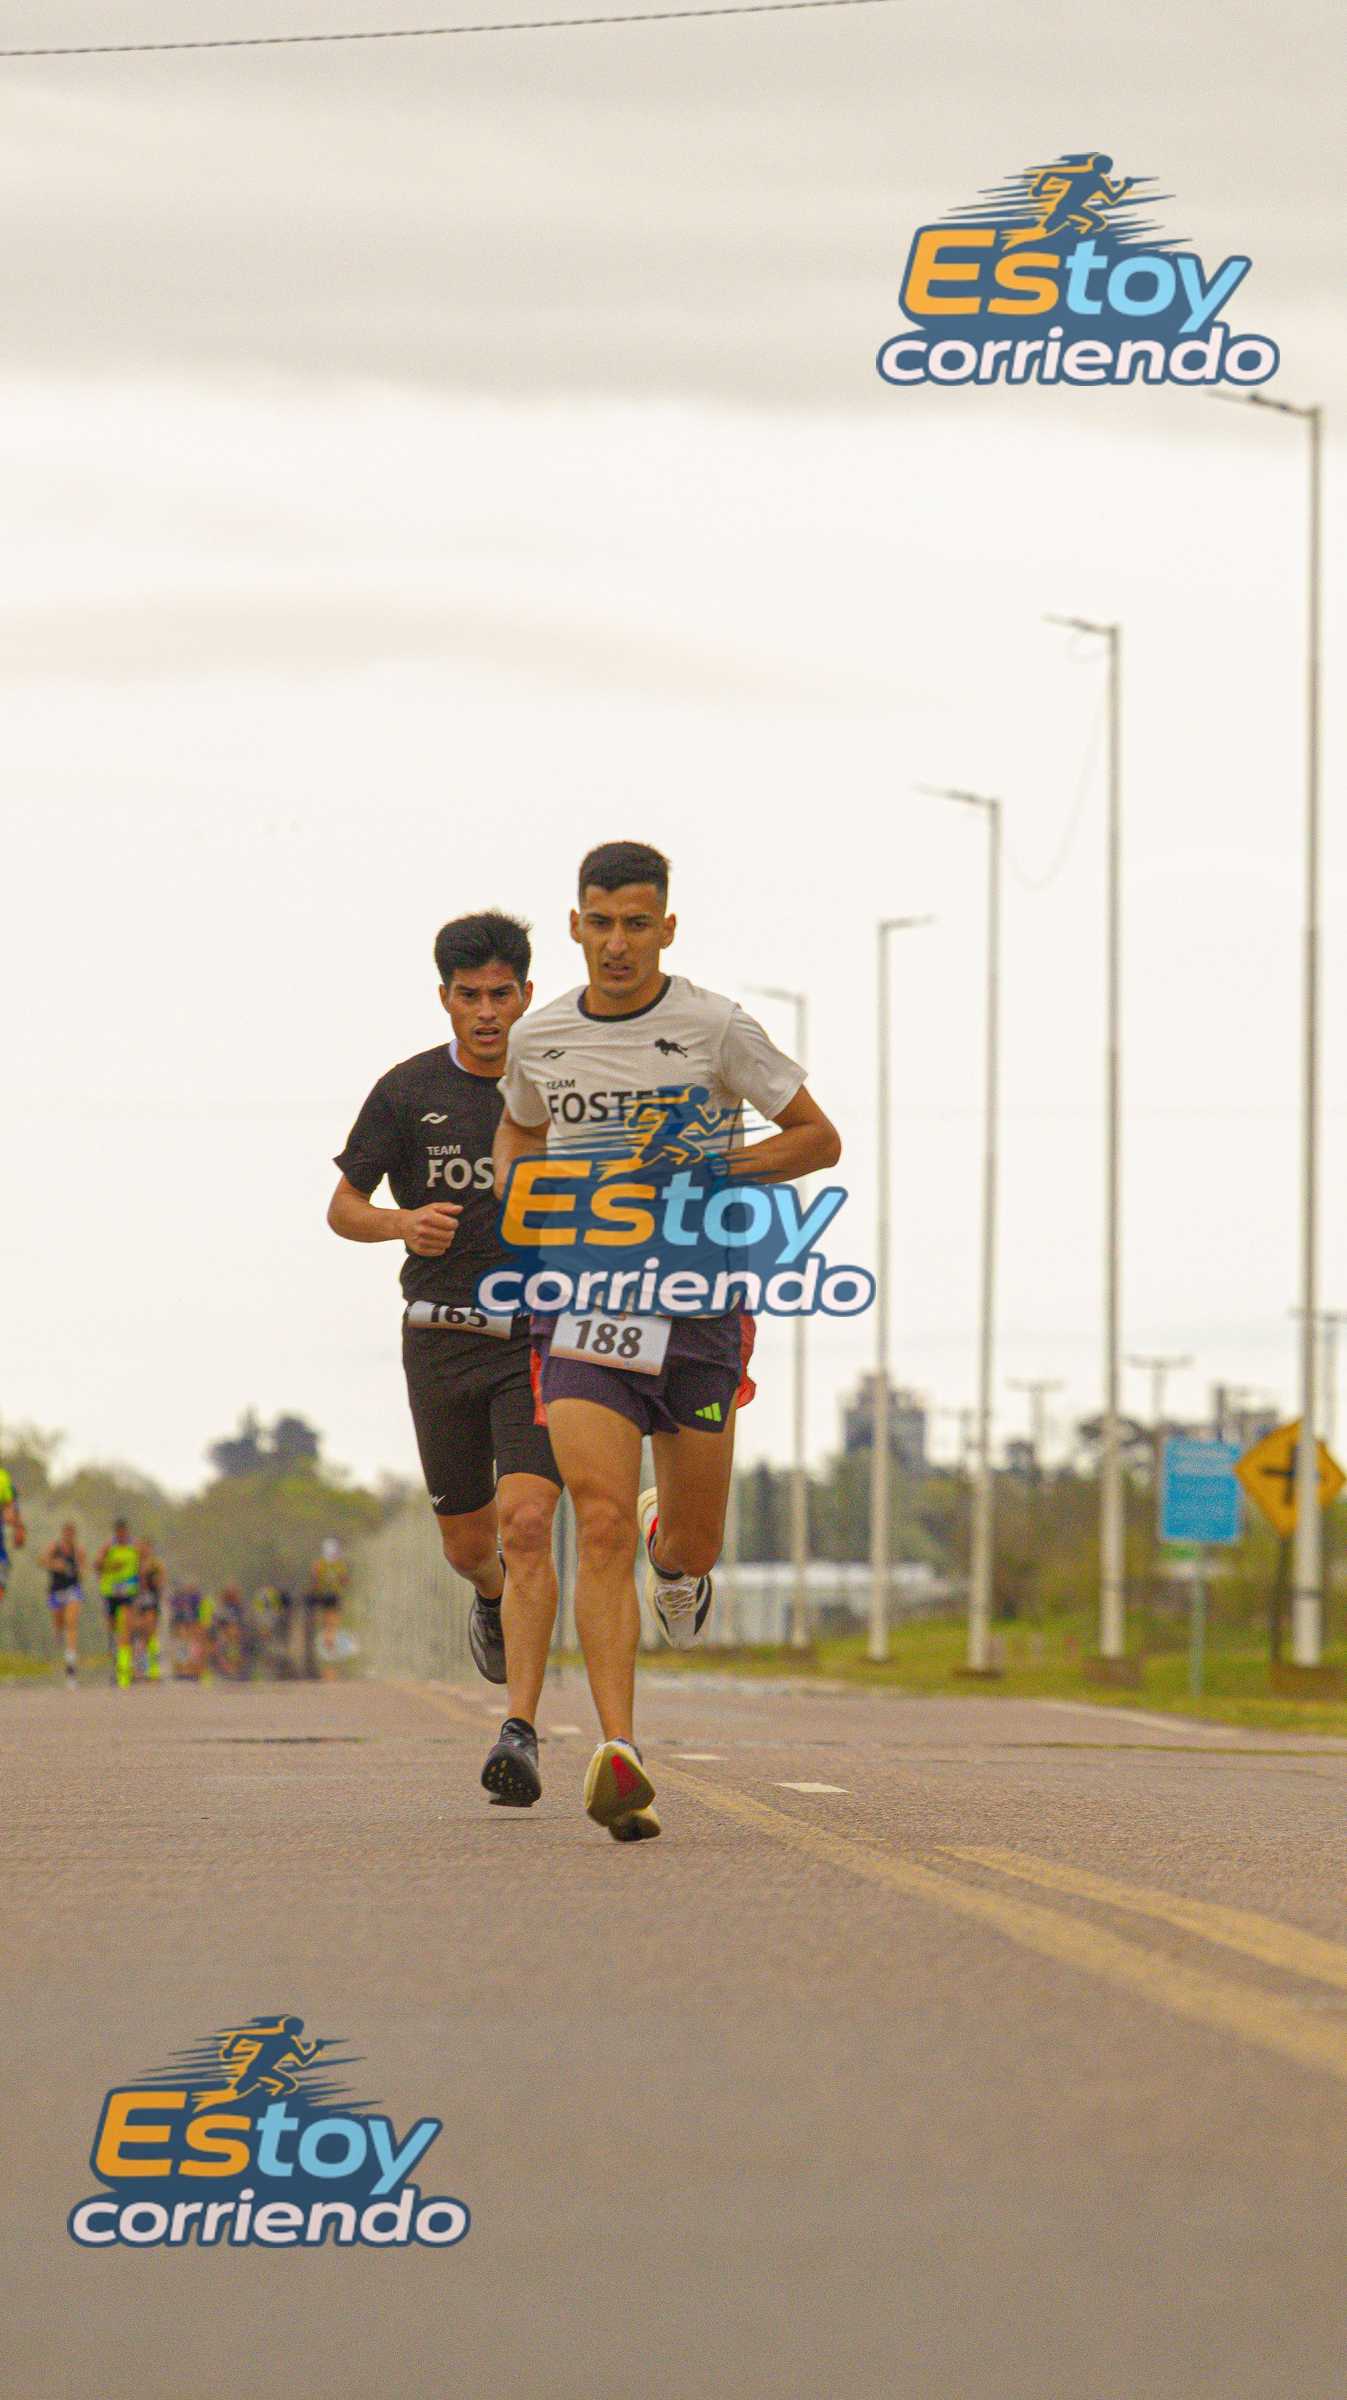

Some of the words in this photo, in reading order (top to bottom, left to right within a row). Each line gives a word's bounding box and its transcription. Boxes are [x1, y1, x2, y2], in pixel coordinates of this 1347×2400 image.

[547, 1079, 575, 1089] TEAM
[426, 1145, 461, 1155] TEAM
[427, 1157, 494, 1189] FOS
[431, 1304, 488, 1328] 165
[575, 1320, 642, 1358] 188
